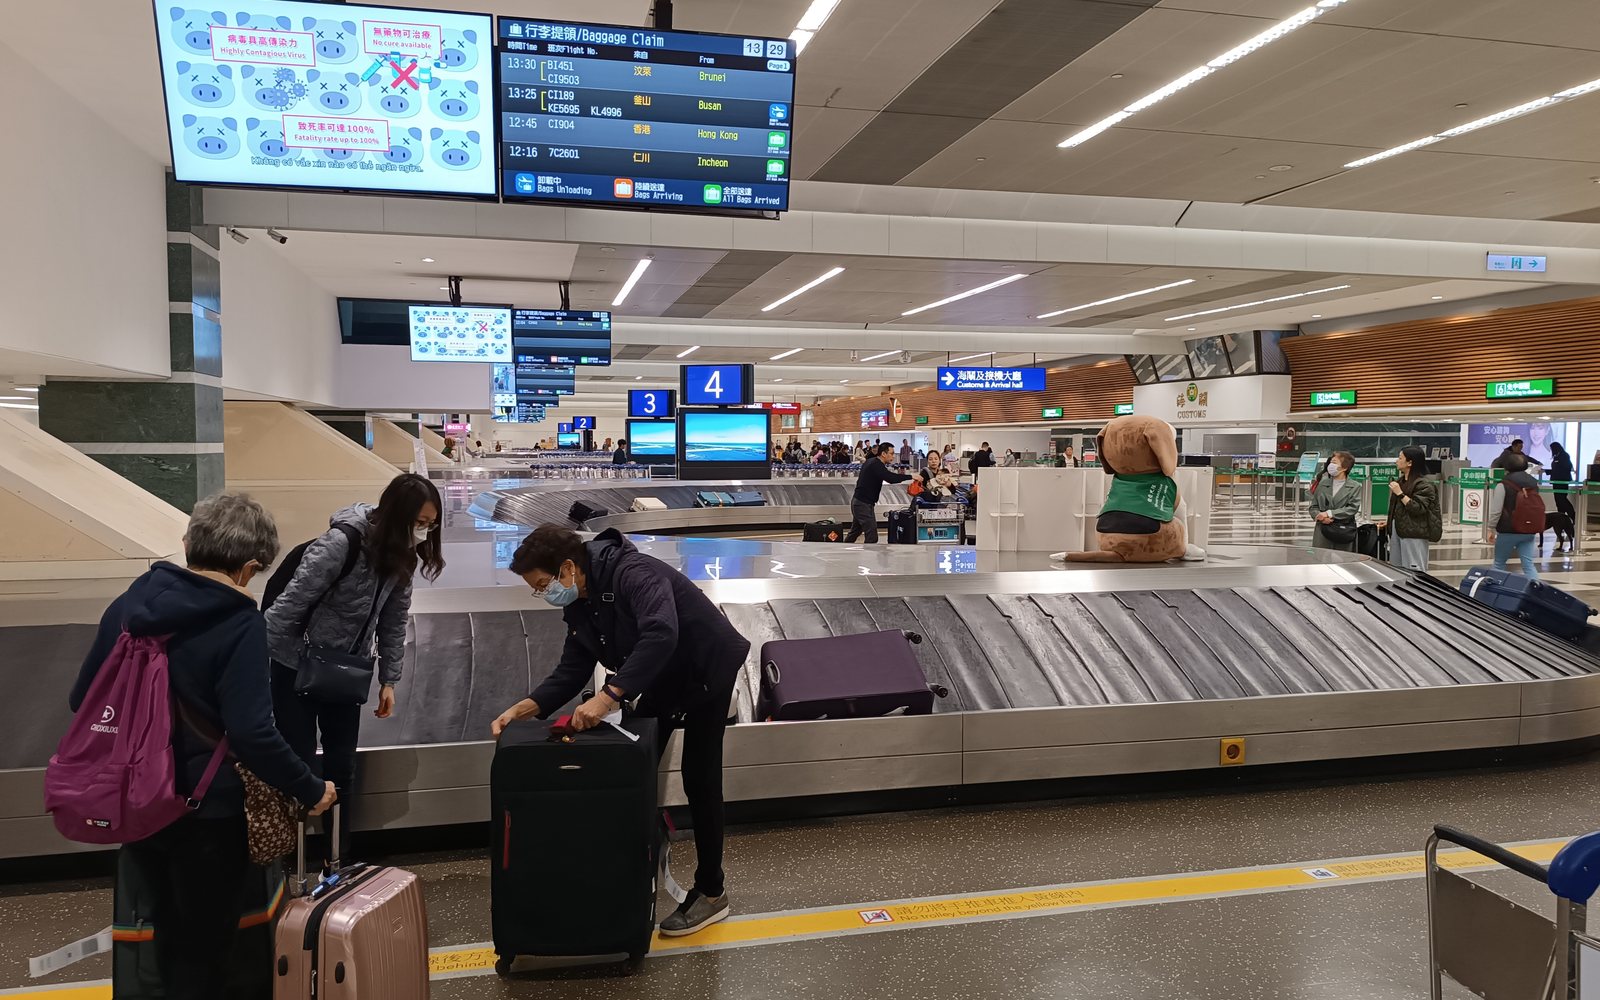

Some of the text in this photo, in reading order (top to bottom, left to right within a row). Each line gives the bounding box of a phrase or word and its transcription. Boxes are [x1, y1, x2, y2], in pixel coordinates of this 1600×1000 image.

[525, 24, 664, 47] 行李提領/Baggage Claim
[220, 47, 244, 55] Highly
[246, 49, 286, 58] Contagious
[587, 46, 598, 55] No.
[699, 56, 714, 64] From
[746, 43, 783, 55] 13 29
[508, 58, 536, 70] 13:30
[547, 60, 574, 71] BI451
[699, 72, 726, 82] Brunei
[548, 74, 580, 85] CI9503
[508, 87, 722, 110] 13:25 CI189 釜山 Busan
[548, 103, 622, 117] KE5695 KL4996
[348, 125, 374, 134] 100%
[509, 117, 739, 140] 12:45 CI904 香港 Hong Kong
[295, 134, 322, 142] Fatality
[251, 156, 280, 167] Không
[282, 158, 293, 166] có
[312, 160, 326, 168] xin
[346, 161, 358, 169] có
[510, 146, 728, 168] 12:16 7C2601 仁川 Incheon
[538, 185, 592, 196] Bags Unloading
[634, 191, 683, 201] Bags Arriving
[736, 196, 752, 204] Bags
[754, 196, 780, 205] Arrived
[704, 370, 724, 399] 4
[644, 393, 656, 414] 3
[1178, 410, 1206, 419] CUSTOMS
[580, 418, 587, 429] 2
[957, 906, 1001, 915] beyond
[1024, 901, 1059, 910] yellow
[437, 960, 486, 970] behind
